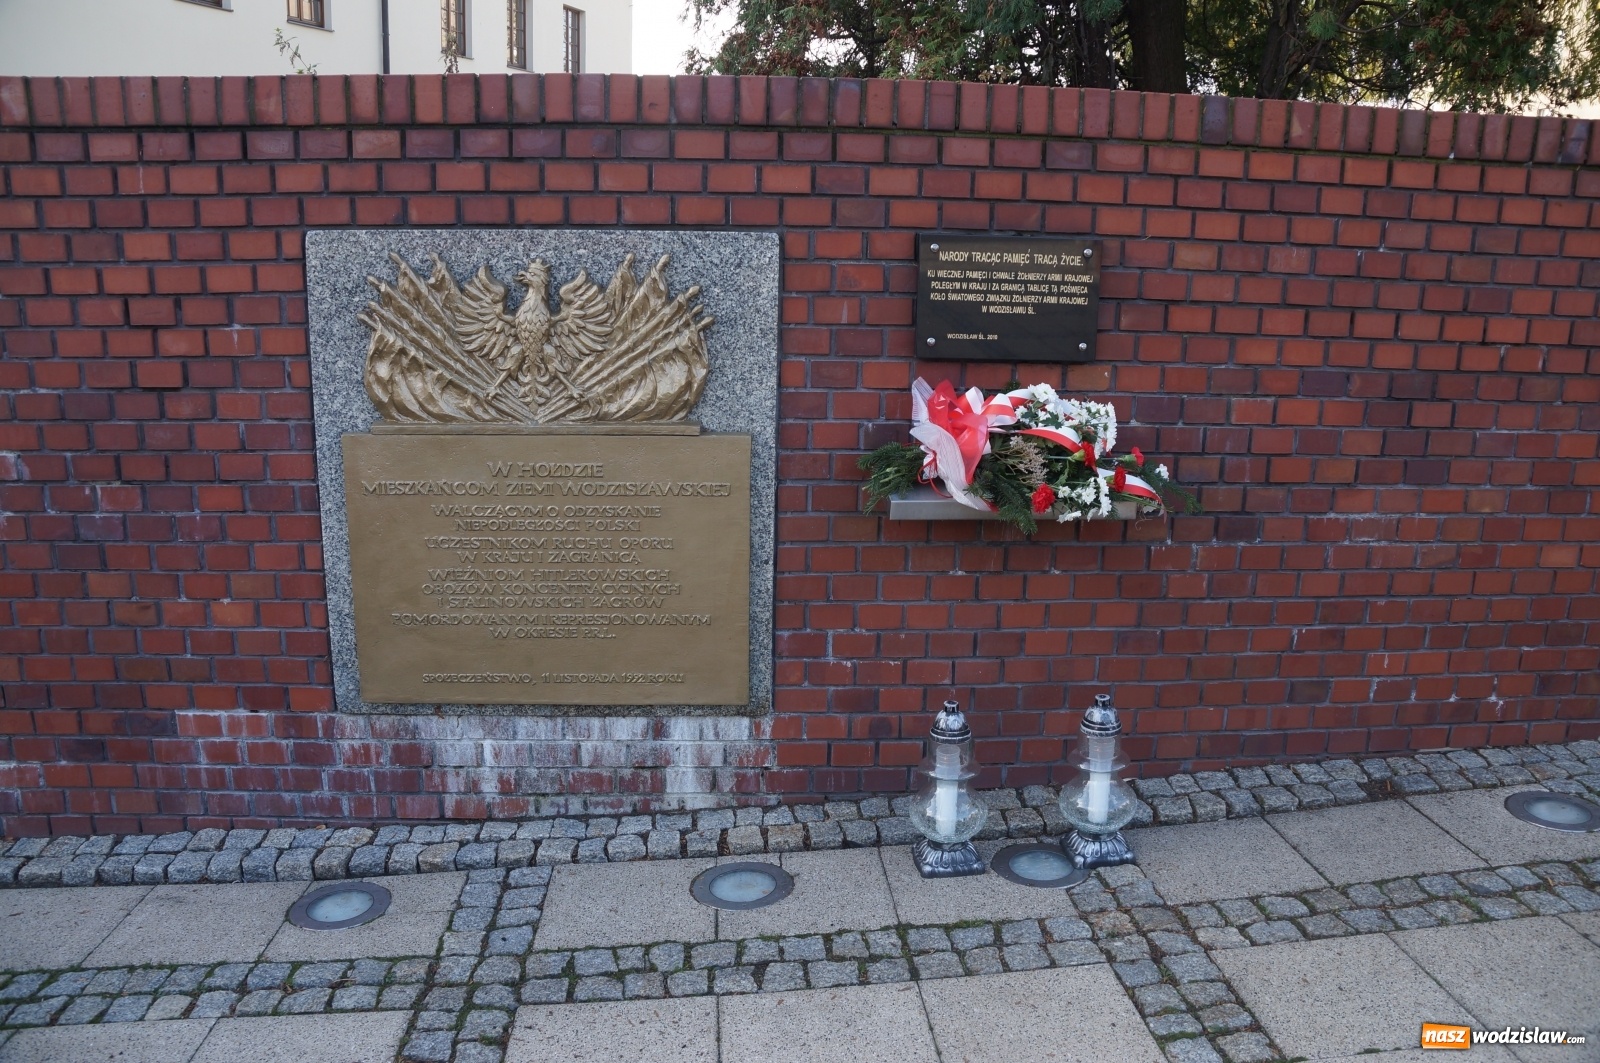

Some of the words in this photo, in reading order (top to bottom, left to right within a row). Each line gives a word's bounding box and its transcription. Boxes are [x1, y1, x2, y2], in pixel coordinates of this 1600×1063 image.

[939, 251, 969, 262] NARODY
[972, 252, 1001, 266] TRACĄC
[1003, 249, 1031, 266] PAMIĘĆ
[1034, 255, 1057, 268] TRACĄ
[1061, 253, 1083, 266] ŻYCIE.
[937, 270, 964, 279] WIECZNEJ
[966, 271, 987, 281] PAMIĘCI
[1017, 271, 1048, 280] ŻOŁNIERZY
[1064, 274, 1093, 283] KRAJOWEJ
[931, 282, 960, 290] POLEGŁYM
[1001, 283, 1025, 293] GRANICĄ
[1027, 284, 1049, 293] TABLICĘ
[1051, 285, 1057, 294] TĄ
[1060, 283, 1088, 294] POŚWIĘCA
[948, 291, 985, 302] ŚWIATOWEGO
[986, 294, 1011, 304] ZWIĄZKU
[1012, 294, 1043, 303] ŻOŁNIERZY
[1059, 296, 1088, 305] KRAJOWEJ
[989, 306, 1026, 314] WODZISŁAWIU
[1028, 304, 1036, 314] ŚL.
[978, 332, 986, 340] ŚL.
[487, 462, 513, 478] W
[517, 462, 603, 478] HOŁDZIE
[361, 480, 499, 497] MIESZKAŃCOM
[506, 482, 554, 497] ZIEMI
[557, 481, 732, 498] WODZISŁAWSKIEJ
[431, 504, 544, 519] WALCZĄCYM
[547, 506, 559, 518] O
[563, 505, 661, 519] ODZYSKANIE
[454, 517, 580, 532] NIEPODLEGŁOŚCI
[585, 520, 641, 531] POLSKI
[425, 537, 548, 549] UCZESTNIKOM
[552, 538, 613, 549] RUCHU
[619, 538, 674, 550] OPORU
[457, 551, 479, 564] W
[483, 551, 535, 564] KRAJU
[537, 551, 544, 564] I
[548, 551, 641, 566] ZAGRANICĄ
[530, 569, 670, 582] HITLEROWSKICH
[422, 581, 496, 595] OBOZÓW
[500, 584, 682, 596] KONCENTRACYJNYCH
[437, 597, 445, 608] I
[448, 597, 585, 609] STALINOWSKICH
[589, 594, 664, 609] ŁAGRÓW
[391, 612, 539, 627] POMORDOWANYM
[550, 614, 711, 626] REPRESJONOWANYM
[489, 626, 511, 639] W
[515, 627, 577, 639] OKRESIE
[422, 671, 536, 685] SPOŁECZEŃSTWO,
[541, 673, 550, 683] 11
[554, 673, 619, 684] LISTOPADA
[621, 672, 645, 684] 1992
[647, 673, 685, 684] ROKU
